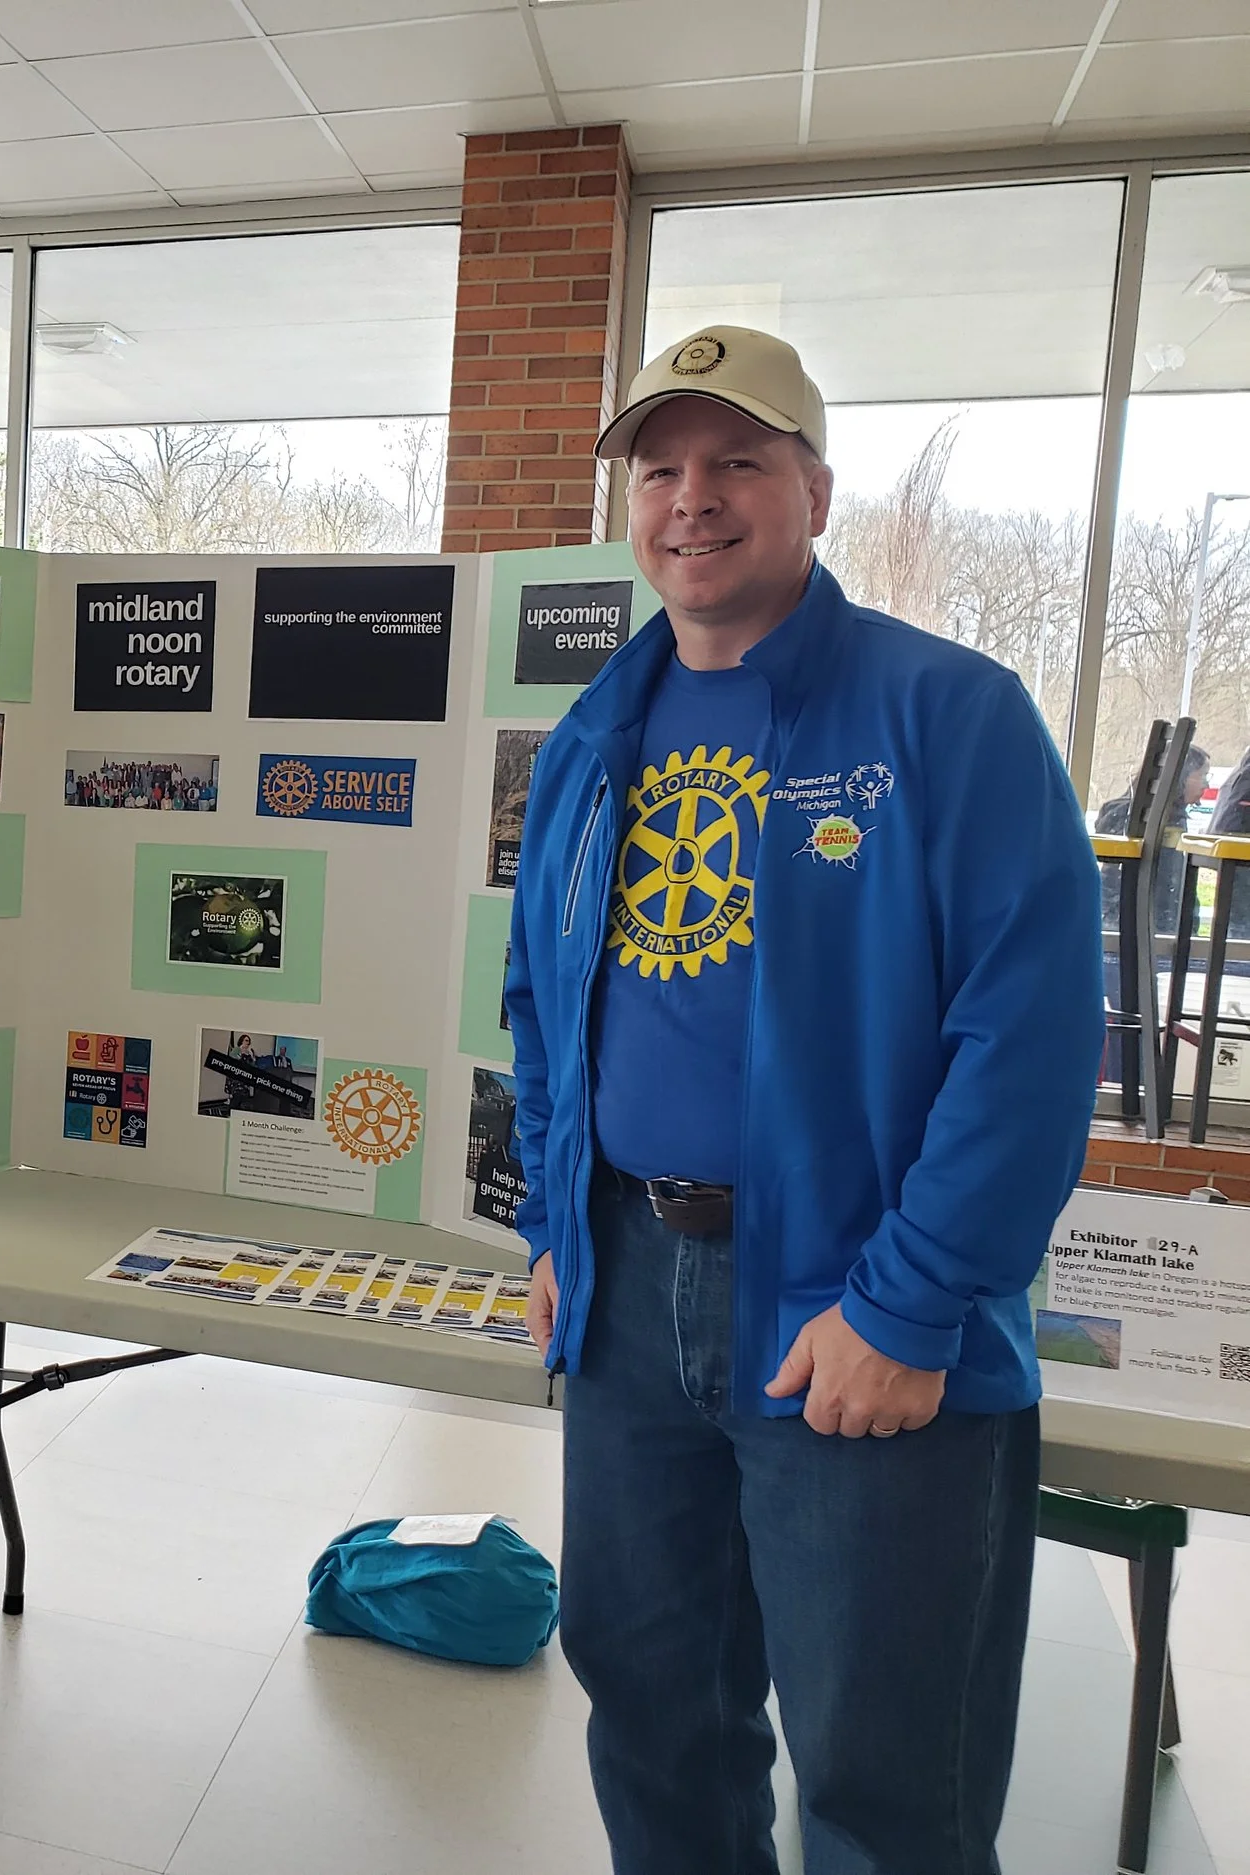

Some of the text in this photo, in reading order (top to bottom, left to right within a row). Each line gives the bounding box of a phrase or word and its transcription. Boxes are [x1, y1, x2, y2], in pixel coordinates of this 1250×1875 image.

[88, 593, 204, 622] midland
[526, 602, 620, 631] upcoming
[264, 611, 442, 626] supporting the environment
[372, 622, 442, 634] committee
[127, 630, 203, 655] noon
[554, 629, 618, 651] events
[115, 661, 201, 693] rotary
[323, 770, 411, 796] SERVICE
[650, 769, 734, 802] ROTARY
[786, 772, 841, 789] Special
[322, 794, 372, 811] ABOVE
[376, 796, 409, 813] SELF
[772, 786, 841, 801] Olympics
[796, 800, 841, 812] Michigan
[814, 834, 860, 846] TENNIS
[822, 828, 849, 836] TEAM
[499, 849, 513, 859] join
[203, 911, 237, 925] Rotary
[614, 894, 748, 954] INTERNATIONAL
[72, 1073, 116, 1086] ROTARY'S
[211, 1058, 253, 1080] pre-program
[256, 1076, 271, 1087] pick
[271, 1083, 286, 1093] one
[285, 1088, 304, 1102] thing
[375, 1080, 407, 1109] ROTARY
[247, 1120, 269, 1129] Month
[270, 1123, 304, 1134] Challenge:
[335, 1106, 387, 1154] INTERNATIONAL
[492, 1168, 515, 1189] help
[480, 1183, 511, 1202] grove
[492, 1203, 507, 1218] up
[1070, 1229, 1199, 1256] Exhibitor 29-A
[1094, 1248, 1156, 1266] Klamath
[1162, 1256, 1195, 1271] lake
[1056, 1260, 1085, 1270] Upper
[1087, 1264, 1127, 1275] Klamath
[1129, 1269, 1150, 1279] lake
[1163, 1273, 1198, 1285] Oregon
[1056, 1271, 1069, 1279] for
[1071, 1274, 1095, 1284] algae
[1097, 1277, 1107, 1285] to
[1110, 1280, 1158, 1291] reproduce
[1174, 1288, 1200, 1298] every
[1203, 1290, 1215, 1298] 15
[1055, 1283, 1072, 1292] The
[1074, 1286, 1092, 1295] lake
[1105, 1291, 1154, 1303] monitored
[1156, 1297, 1174, 1305] and
[1177, 1300, 1212, 1310] tracked
[1070, 1297, 1119, 1309] blue-green
[1150, 1348, 1182, 1360] Follow
[1199, 1354, 1213, 1363] for
[1129, 1359, 1198, 1374] more fun facts
